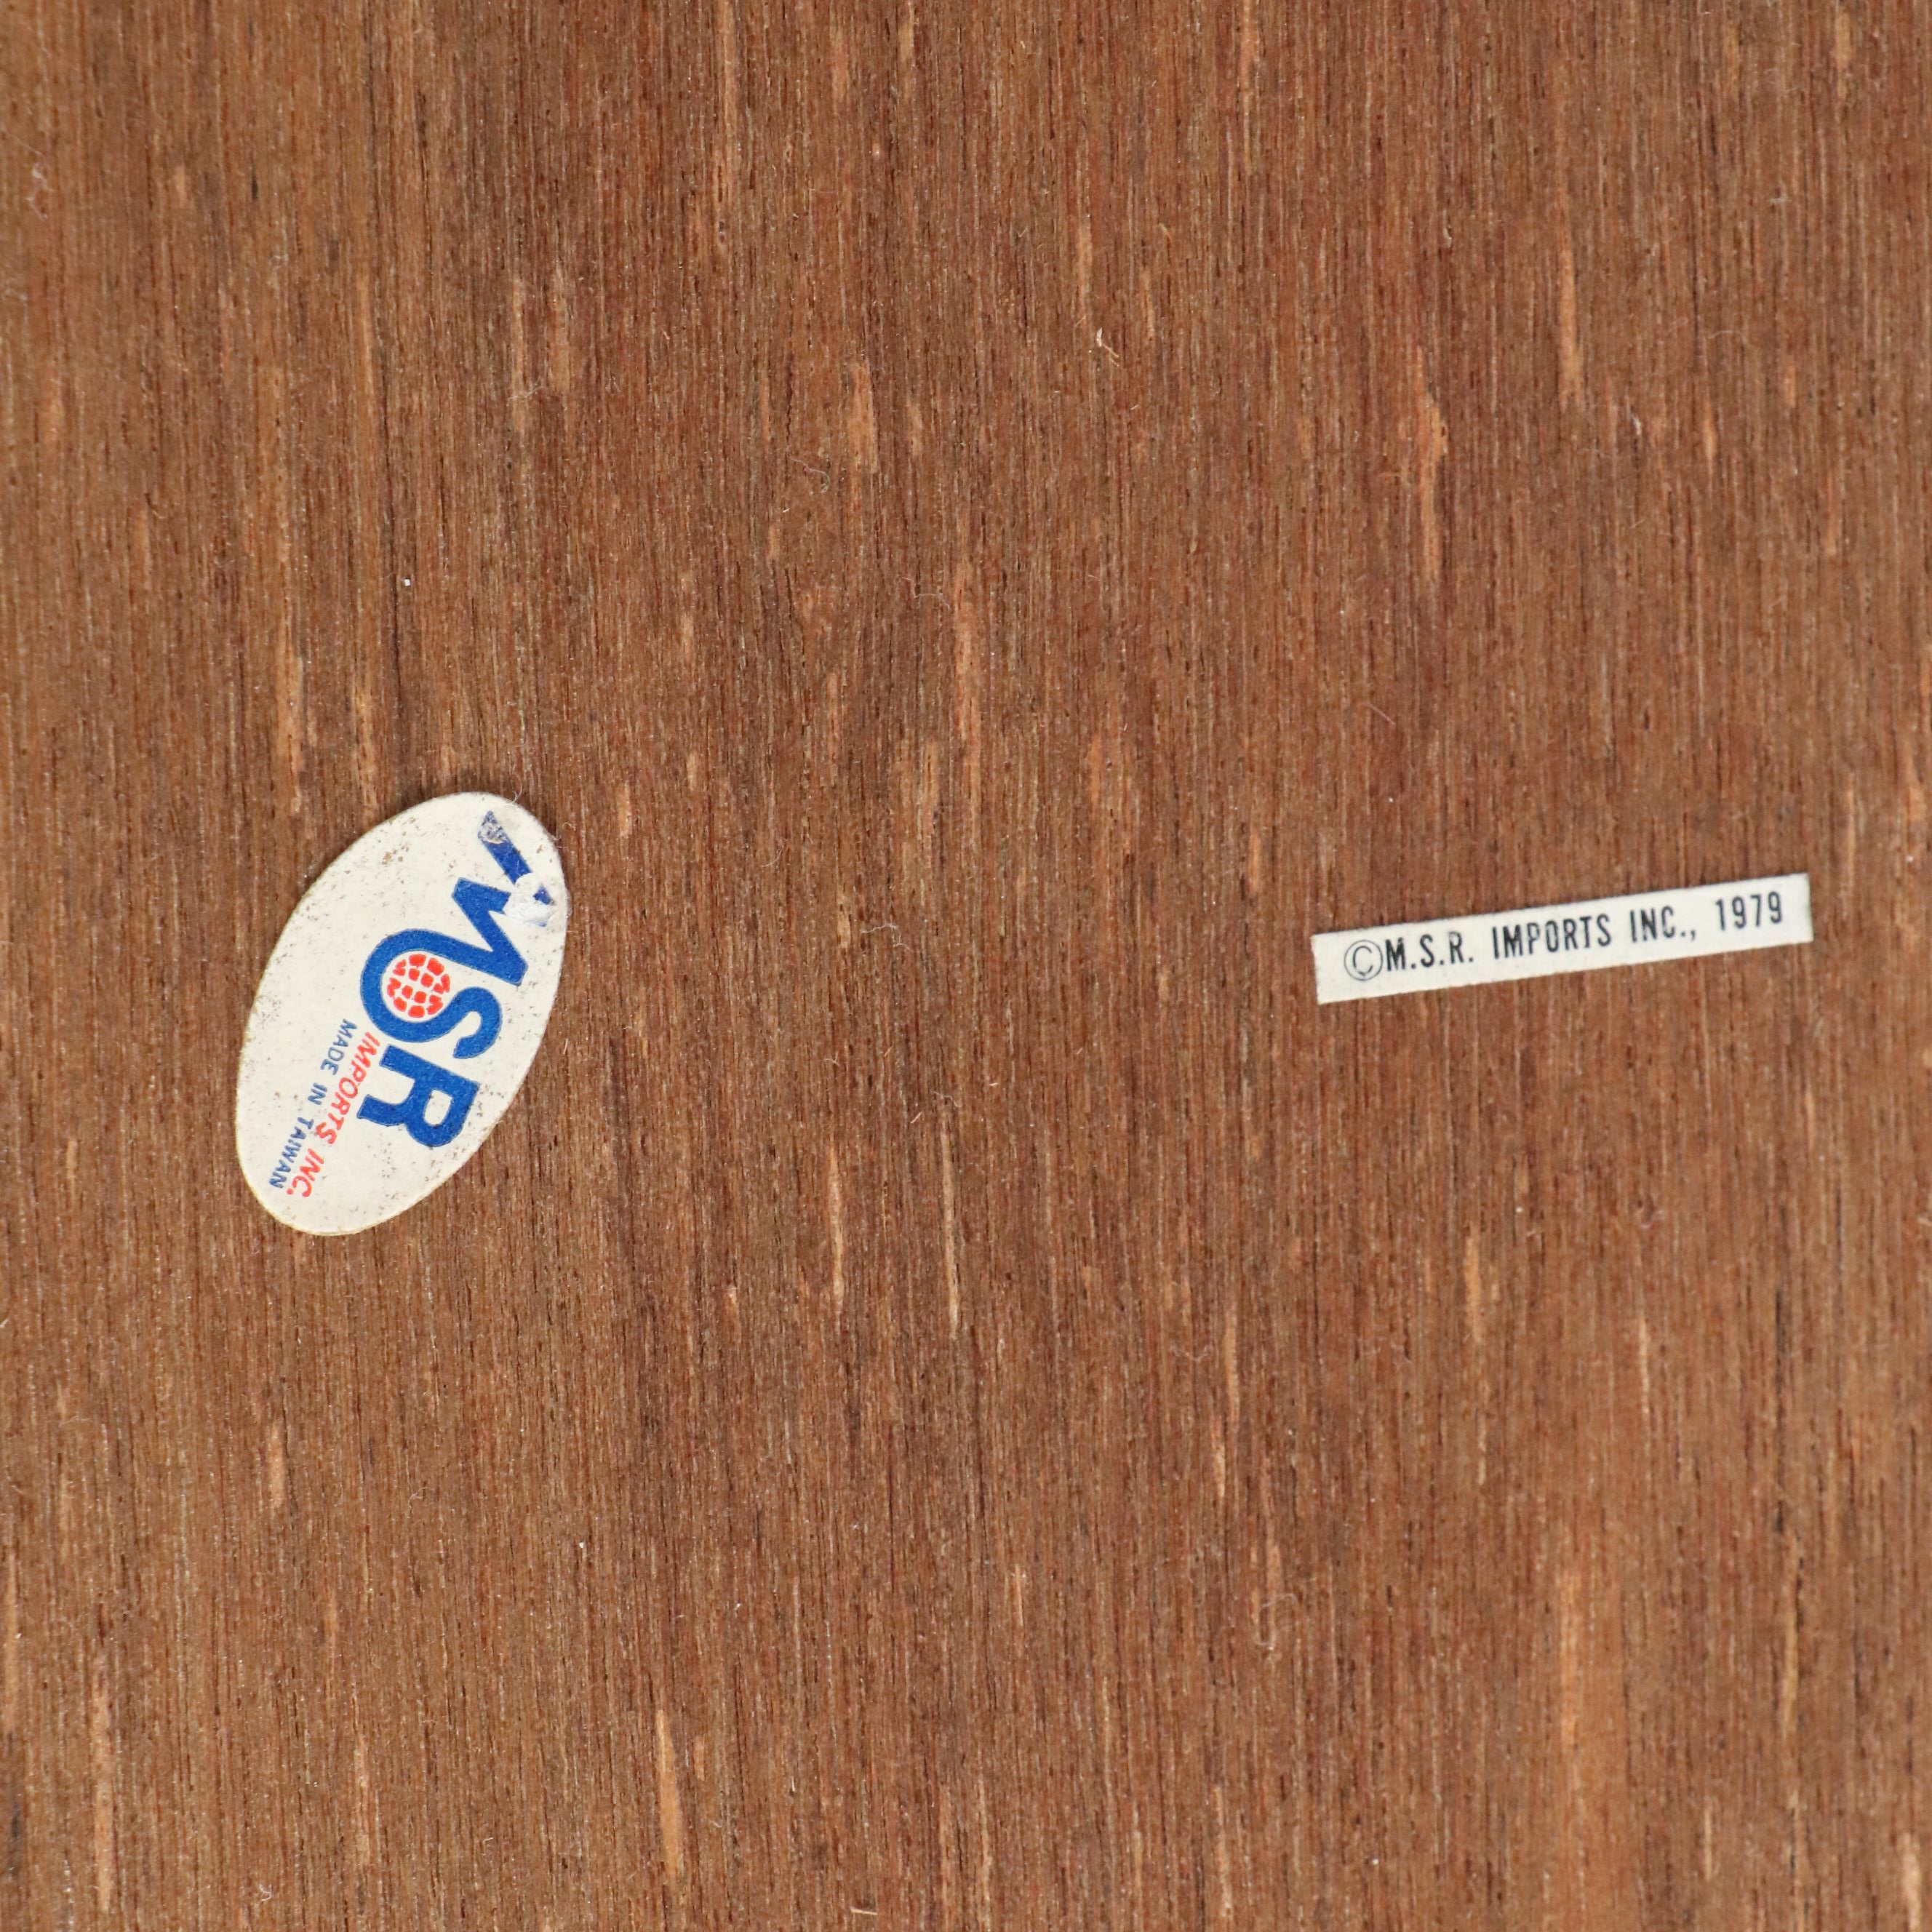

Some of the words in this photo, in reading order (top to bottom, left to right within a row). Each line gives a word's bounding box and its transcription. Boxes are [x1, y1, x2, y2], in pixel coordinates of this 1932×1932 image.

[1491, 914, 1611, 959] IMPORTS
[1629, 906, 1696, 943] INC.,
[1715, 890, 1783, 931] 1979
[320, 1018, 358, 1076] MADE
[308, 1082, 327, 1106] IN
[319, 1031, 381, 1144] IMPORTS
[268, 1116, 315, 1189] TAIWAN
[287, 1149, 325, 1198] INC.
